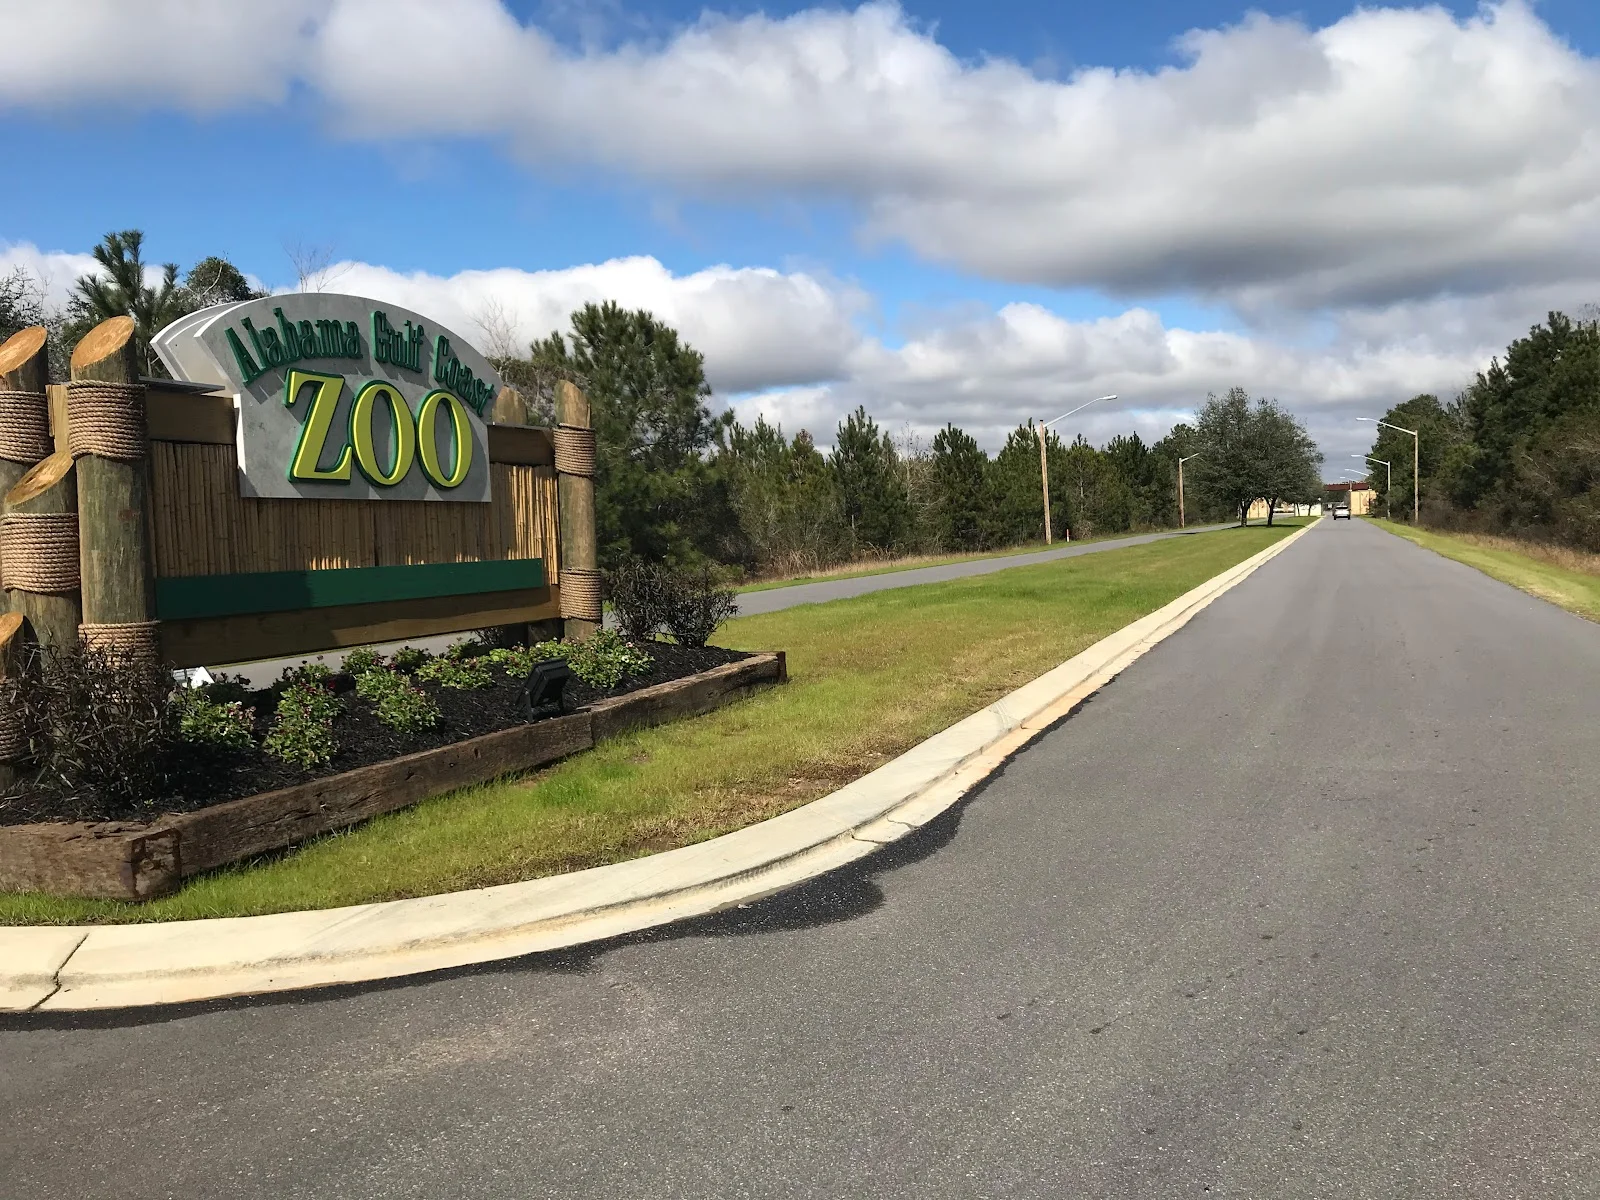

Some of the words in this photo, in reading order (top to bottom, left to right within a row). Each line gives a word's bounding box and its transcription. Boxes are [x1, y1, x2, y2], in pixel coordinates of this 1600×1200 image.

[225, 307, 363, 386] Alabama
[371, 310, 424, 373] Gulf
[433, 335, 495, 416] Coast
[284, 367, 473, 489] ZOO
